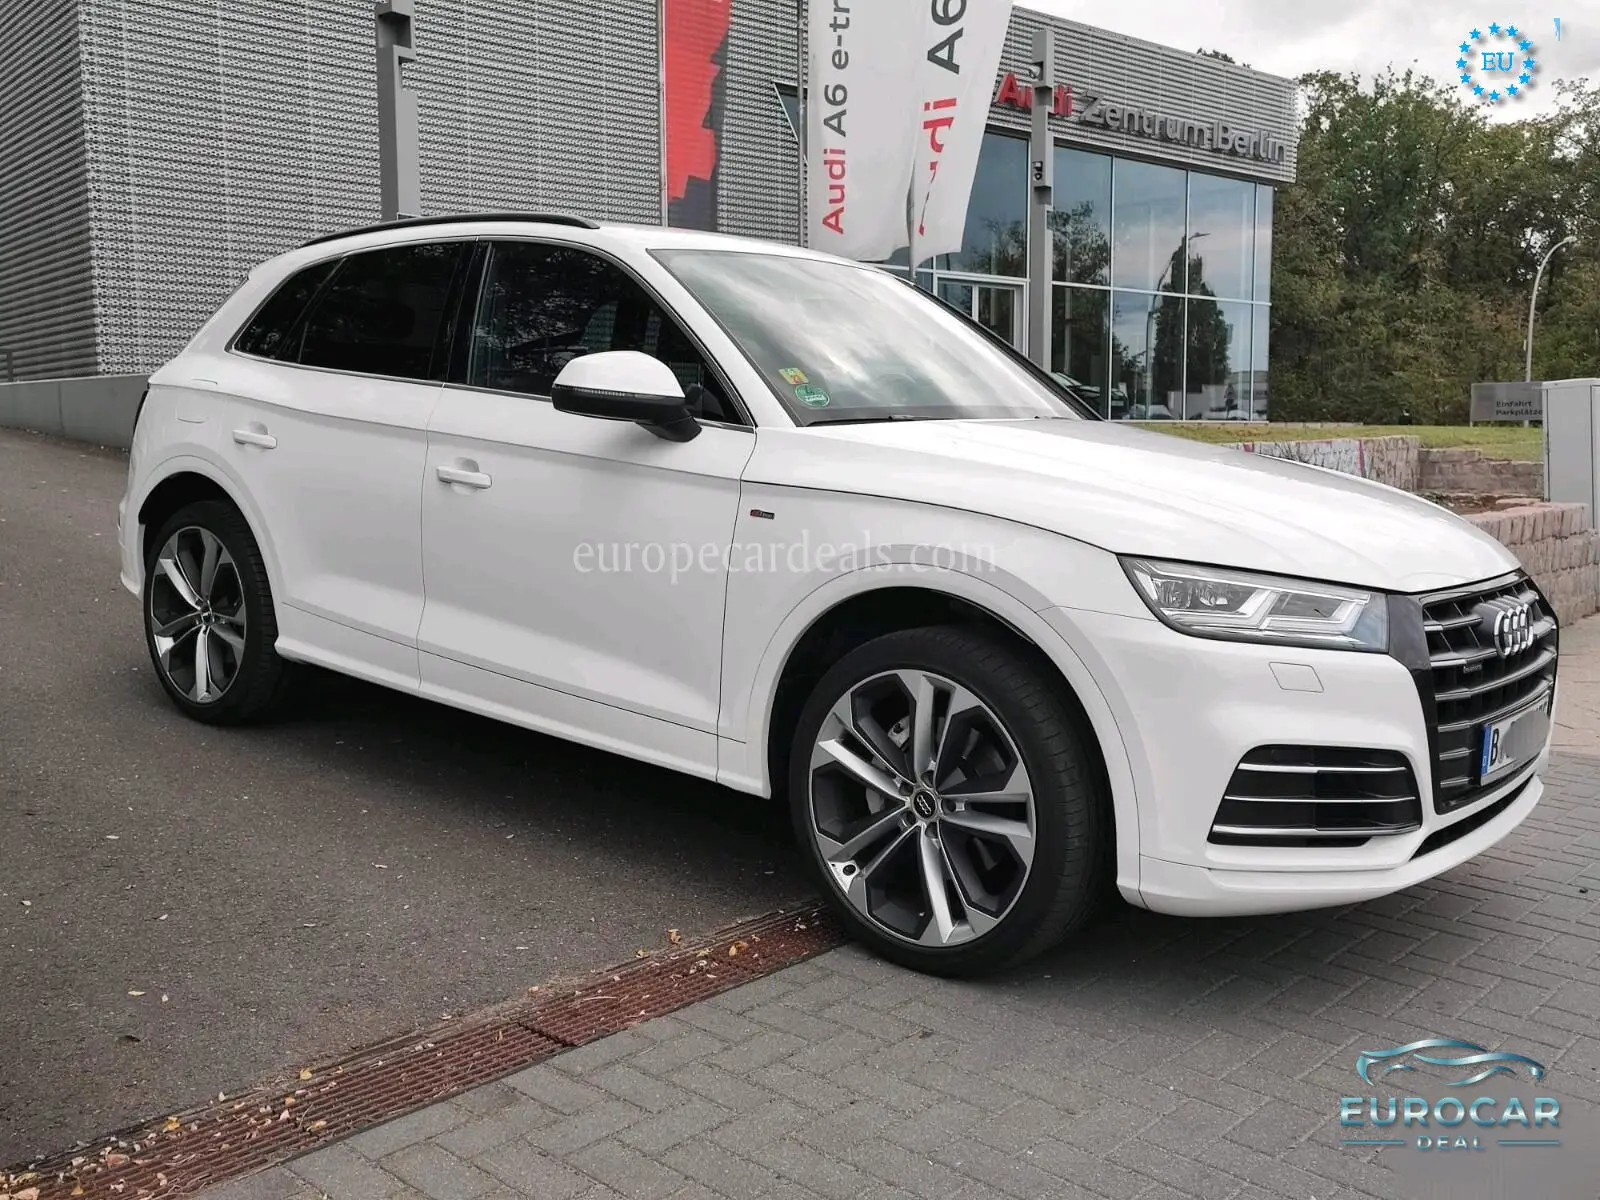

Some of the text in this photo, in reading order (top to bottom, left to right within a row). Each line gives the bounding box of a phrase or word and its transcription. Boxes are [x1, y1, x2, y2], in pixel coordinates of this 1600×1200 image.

[927, 0, 968, 75] A6
[823, 84, 848, 137] A6
[1079, 91, 1209, 148] Zentrum
[1212, 119, 1287, 163] Berlin
[822, 147, 847, 235] Audi
